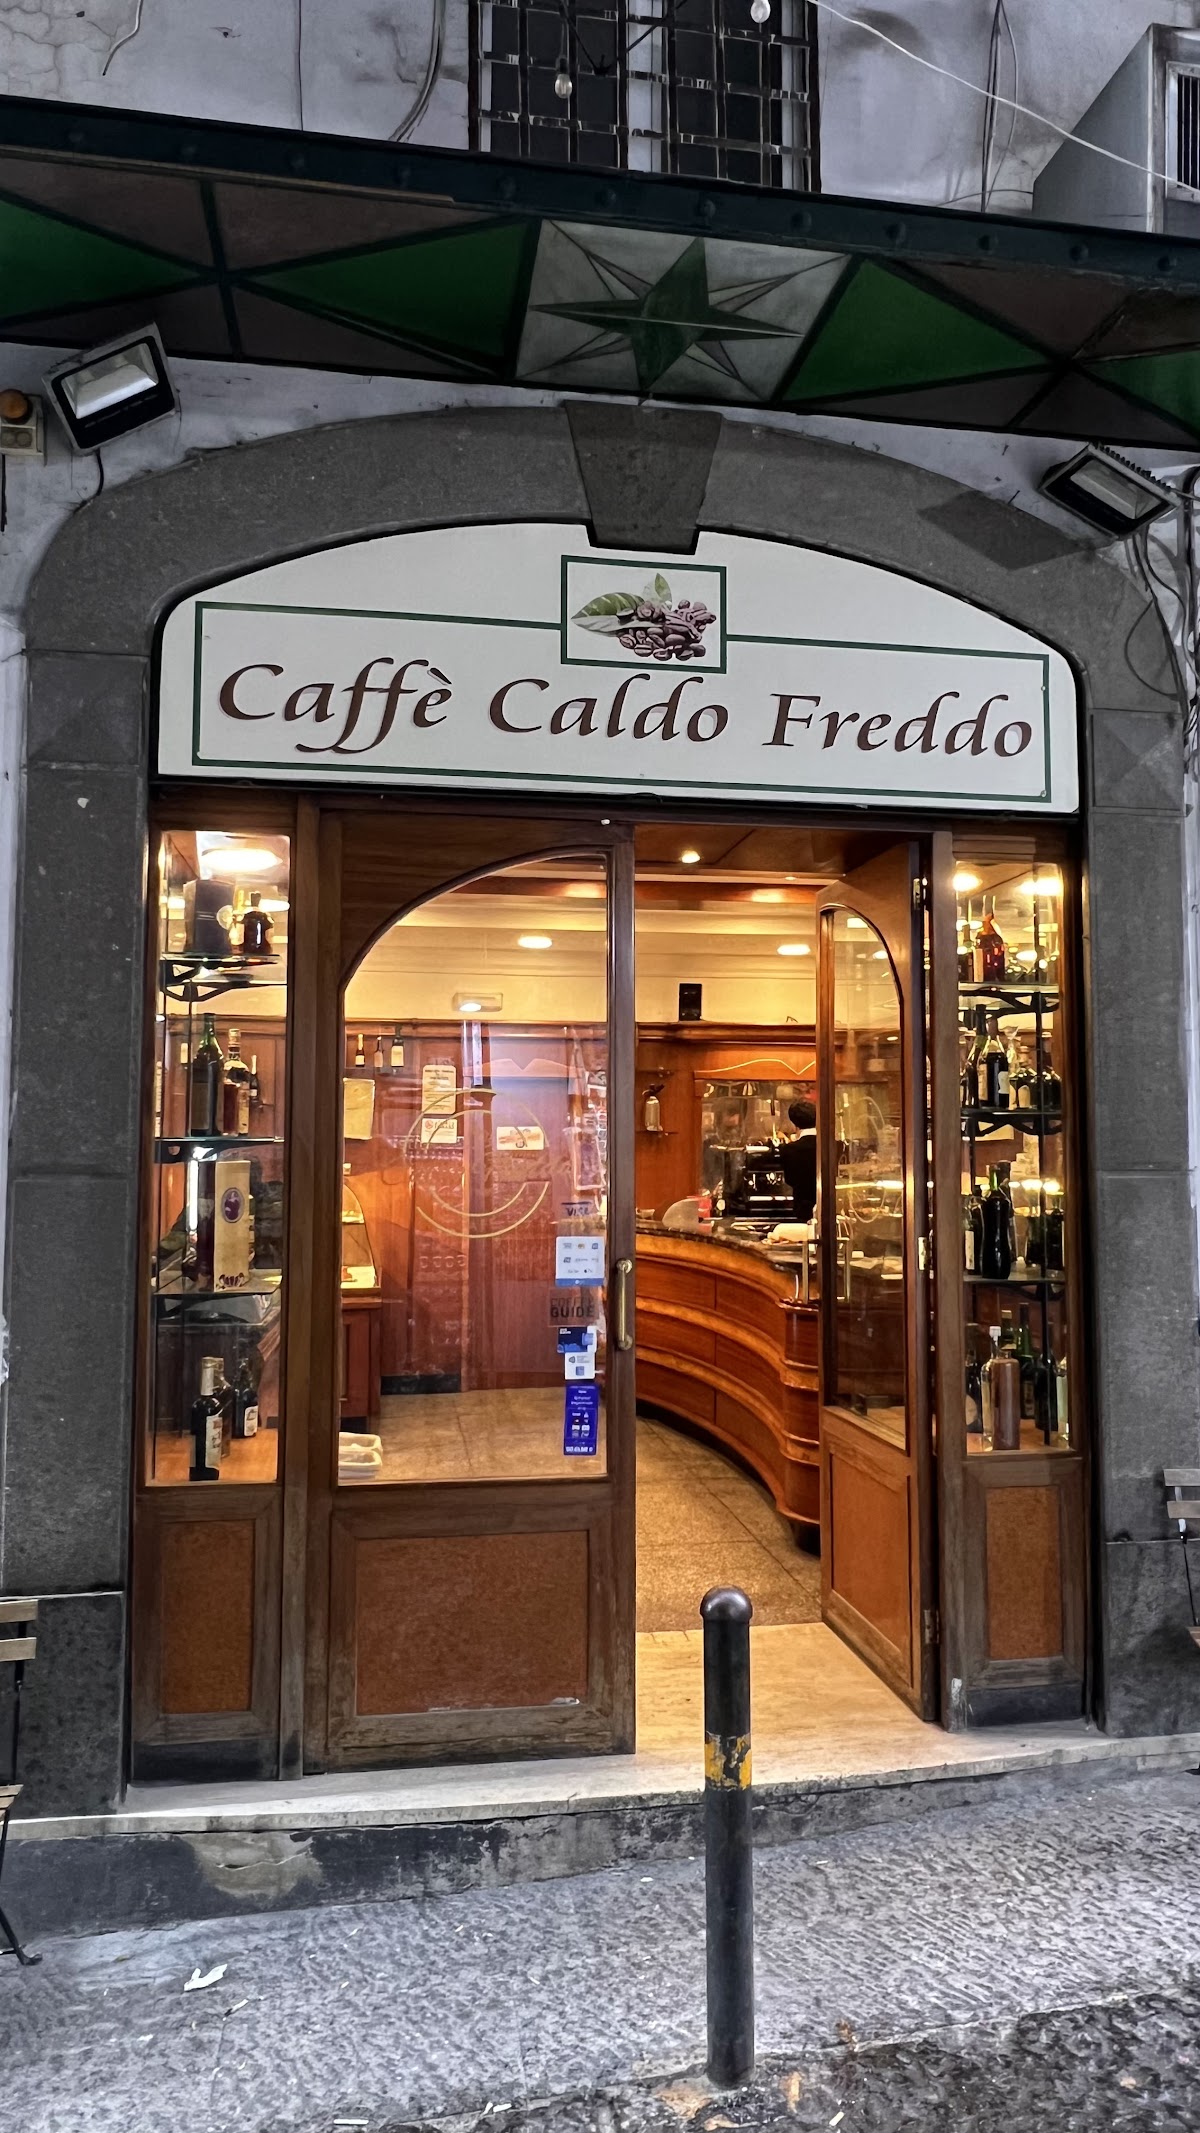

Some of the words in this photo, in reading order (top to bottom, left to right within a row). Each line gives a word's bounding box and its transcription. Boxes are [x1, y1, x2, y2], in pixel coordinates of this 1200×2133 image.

[219, 656, 453, 755] Caffè
[489, 673, 729, 743] Caldo
[762, 691, 1032, 758] Freddo
[550, 1305, 595, 1319] GUIDE
